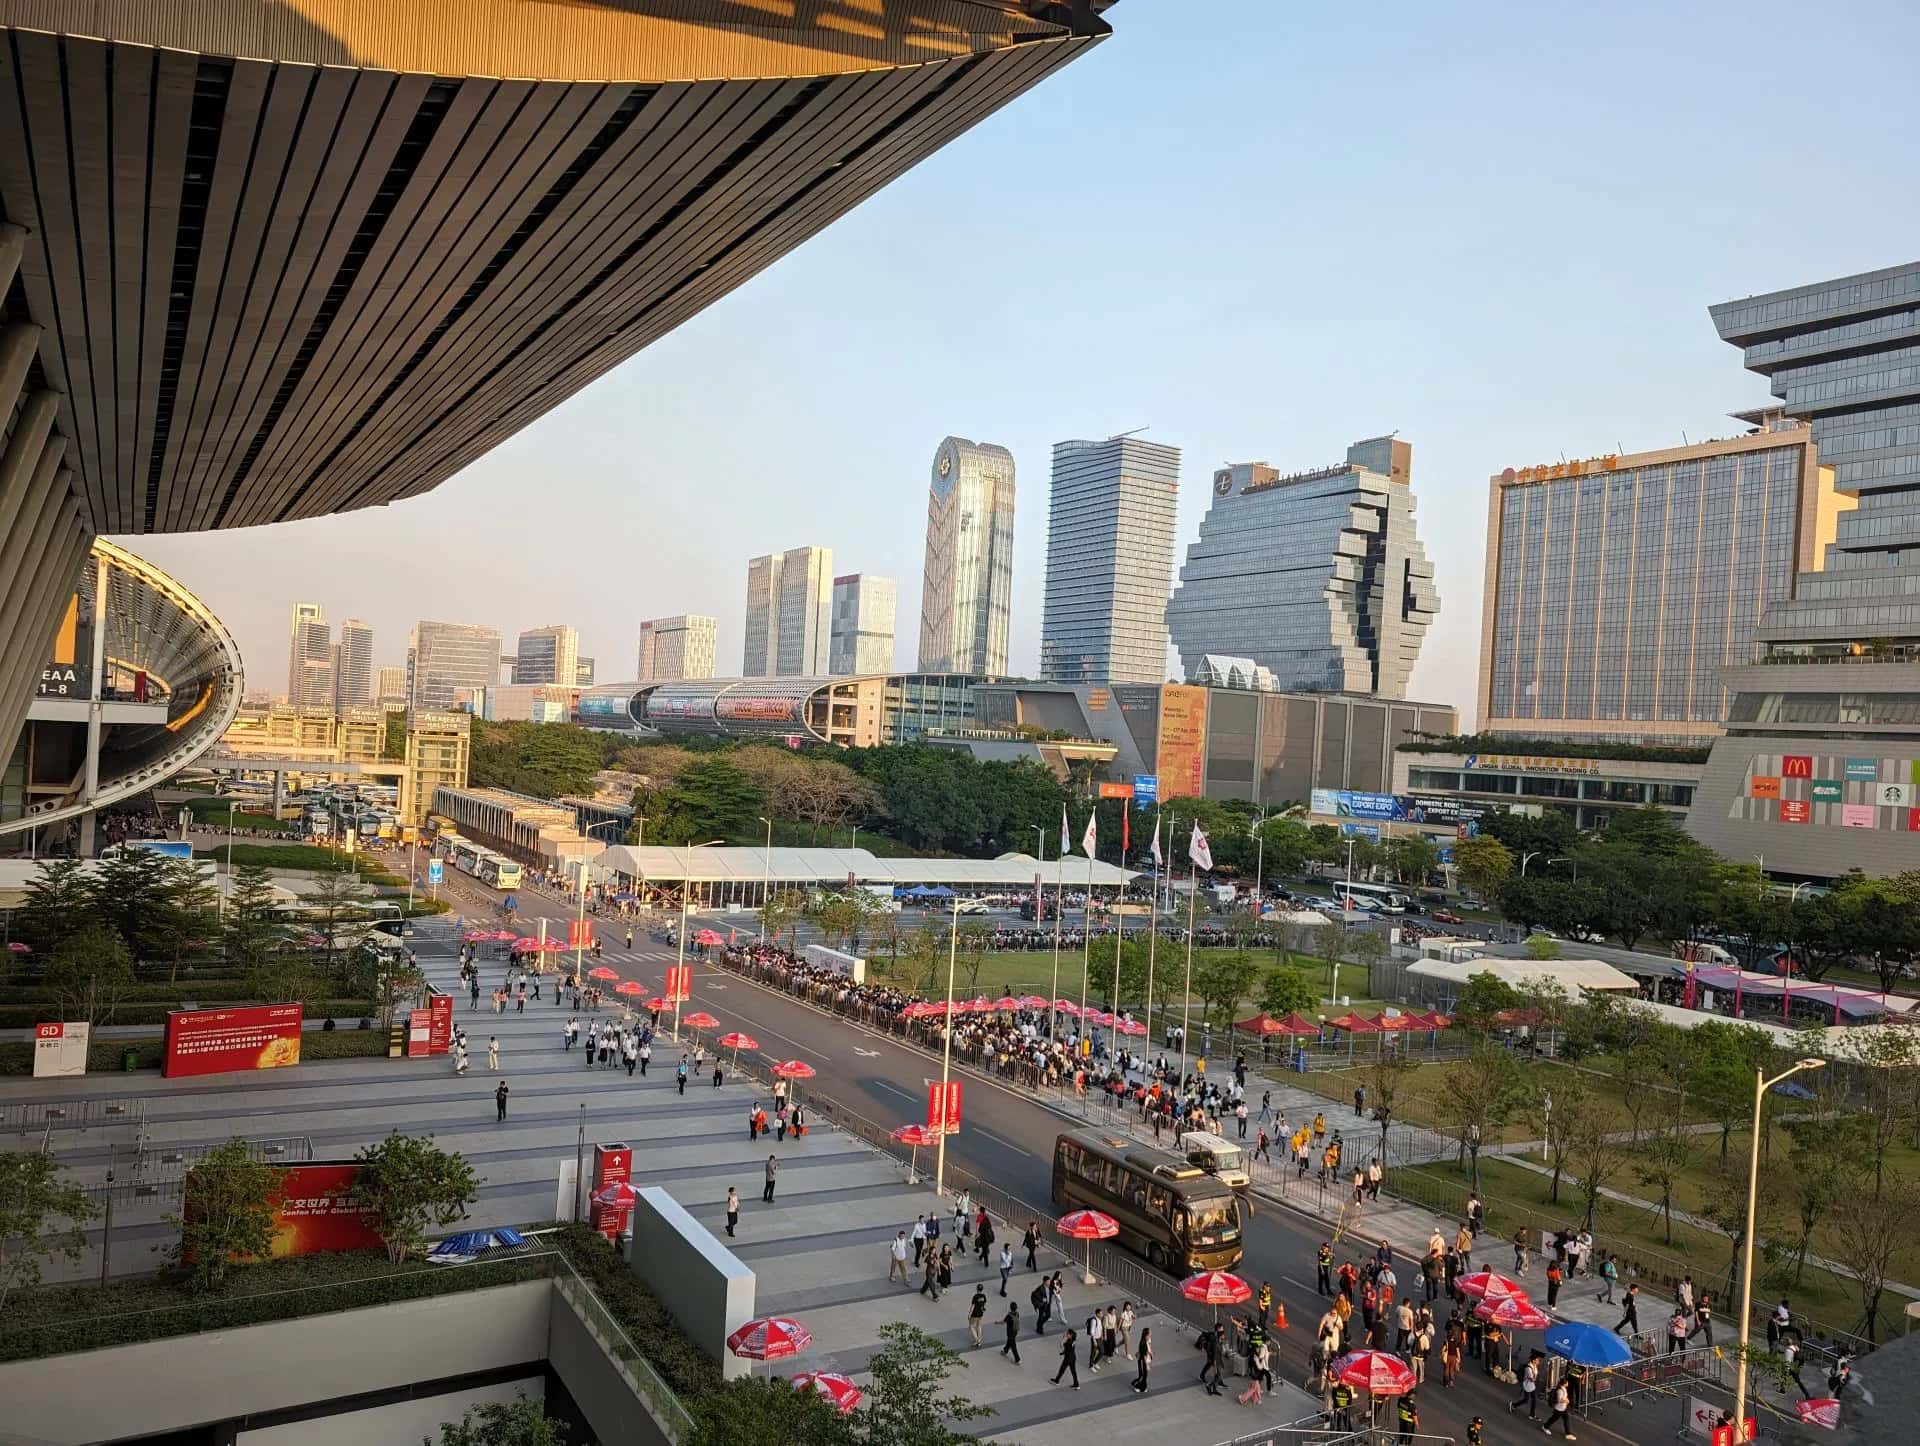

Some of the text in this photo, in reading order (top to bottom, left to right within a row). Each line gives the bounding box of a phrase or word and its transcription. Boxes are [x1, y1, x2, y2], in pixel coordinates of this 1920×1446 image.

[1562, 767, 1587, 775] TRADING
[1352, 800, 1392, 811] EXPORT EXPO
[1427, 807, 1450, 815] EXPORT
[41, 1025, 59, 1037] 6D
[311, 1208, 327, 1216] Fair
